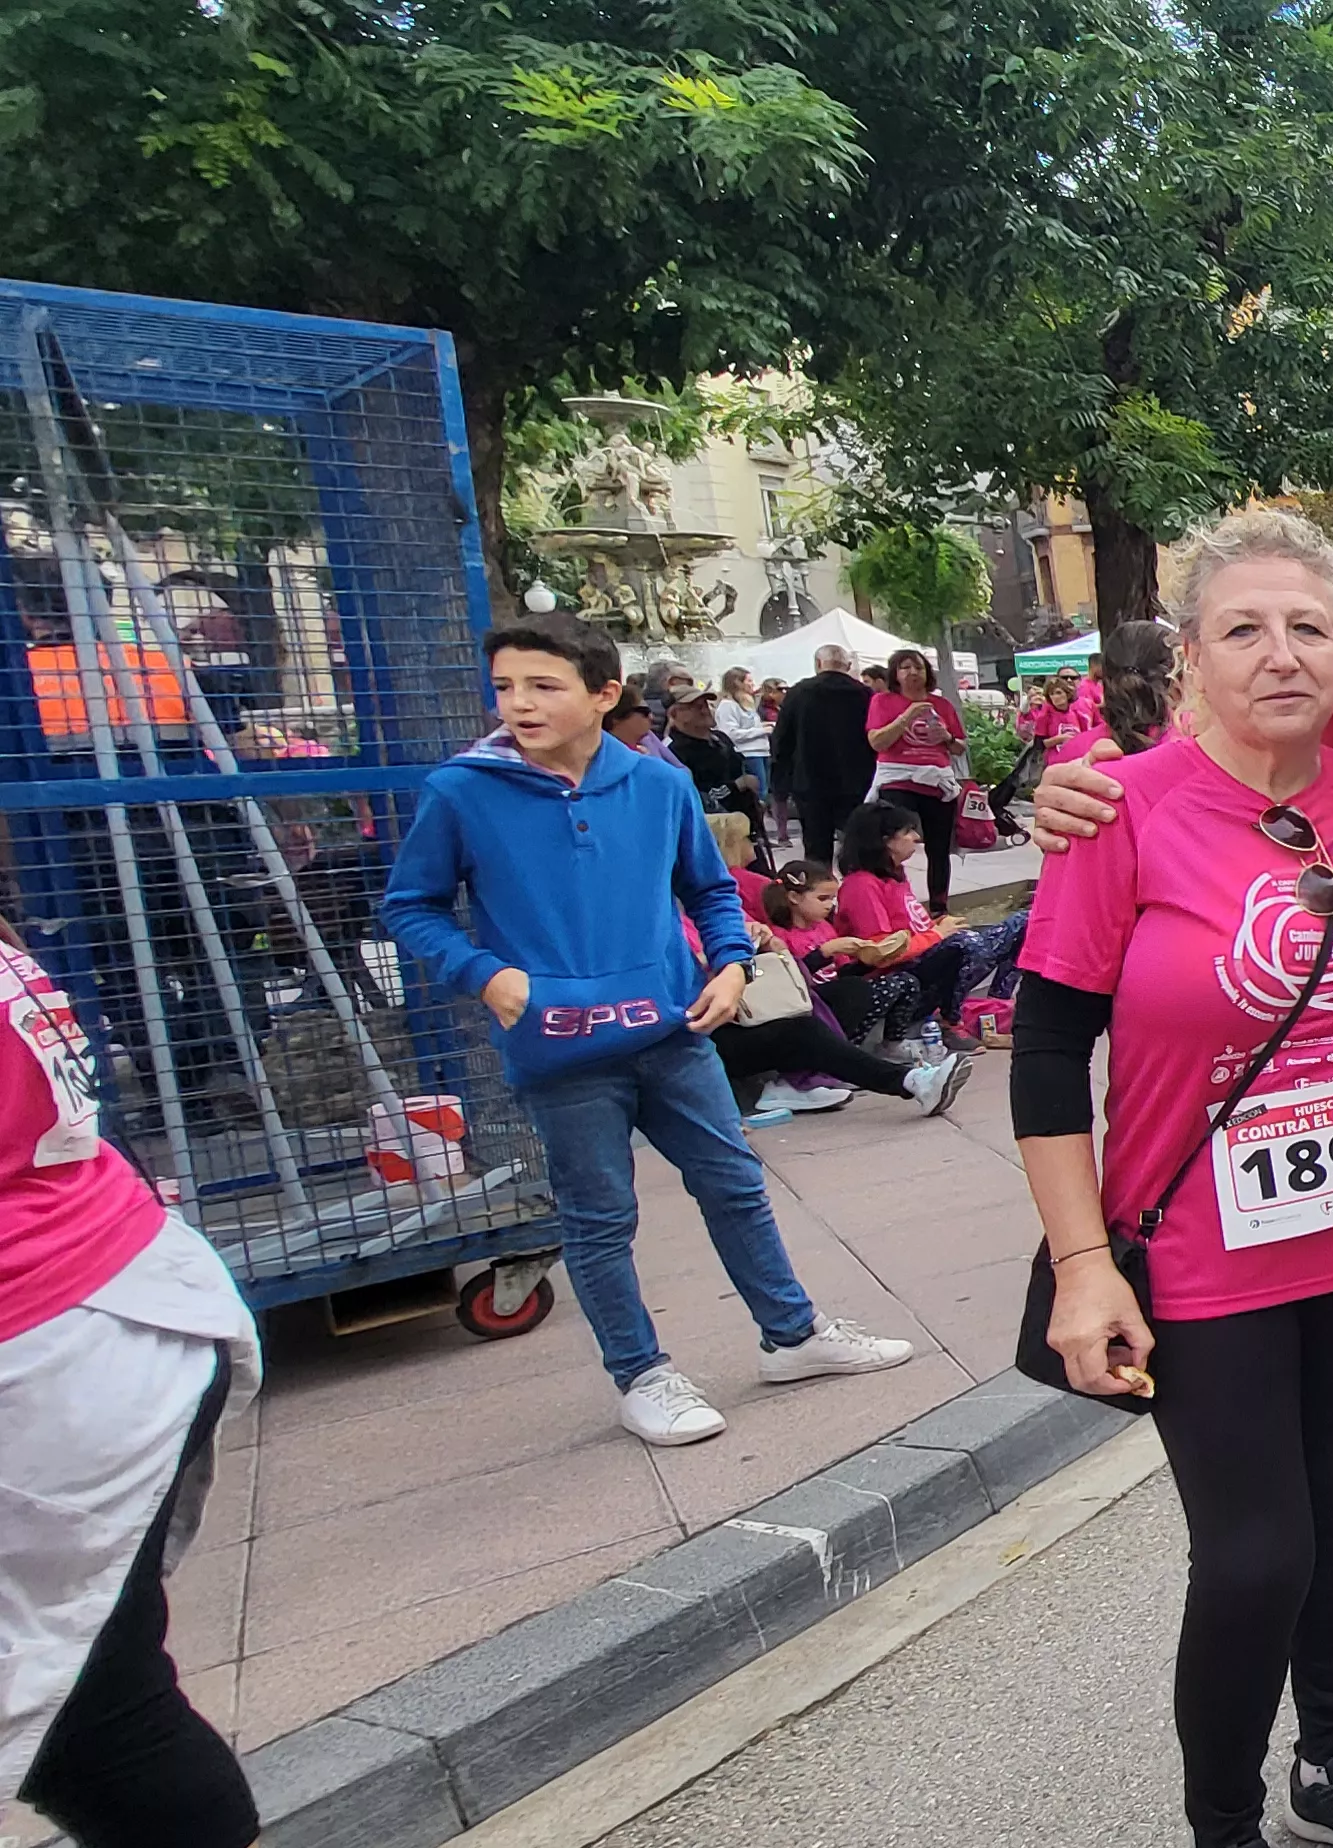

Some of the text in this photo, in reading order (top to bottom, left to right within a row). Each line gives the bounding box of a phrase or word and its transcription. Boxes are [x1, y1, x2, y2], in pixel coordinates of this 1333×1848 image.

[543, 998, 662, 1039] SPG
[1232, 1109, 1263, 1125] EDICIÓN
[1237, 1119, 1310, 1142] CONTRA
[1314, 1114, 1333, 1129] EL
